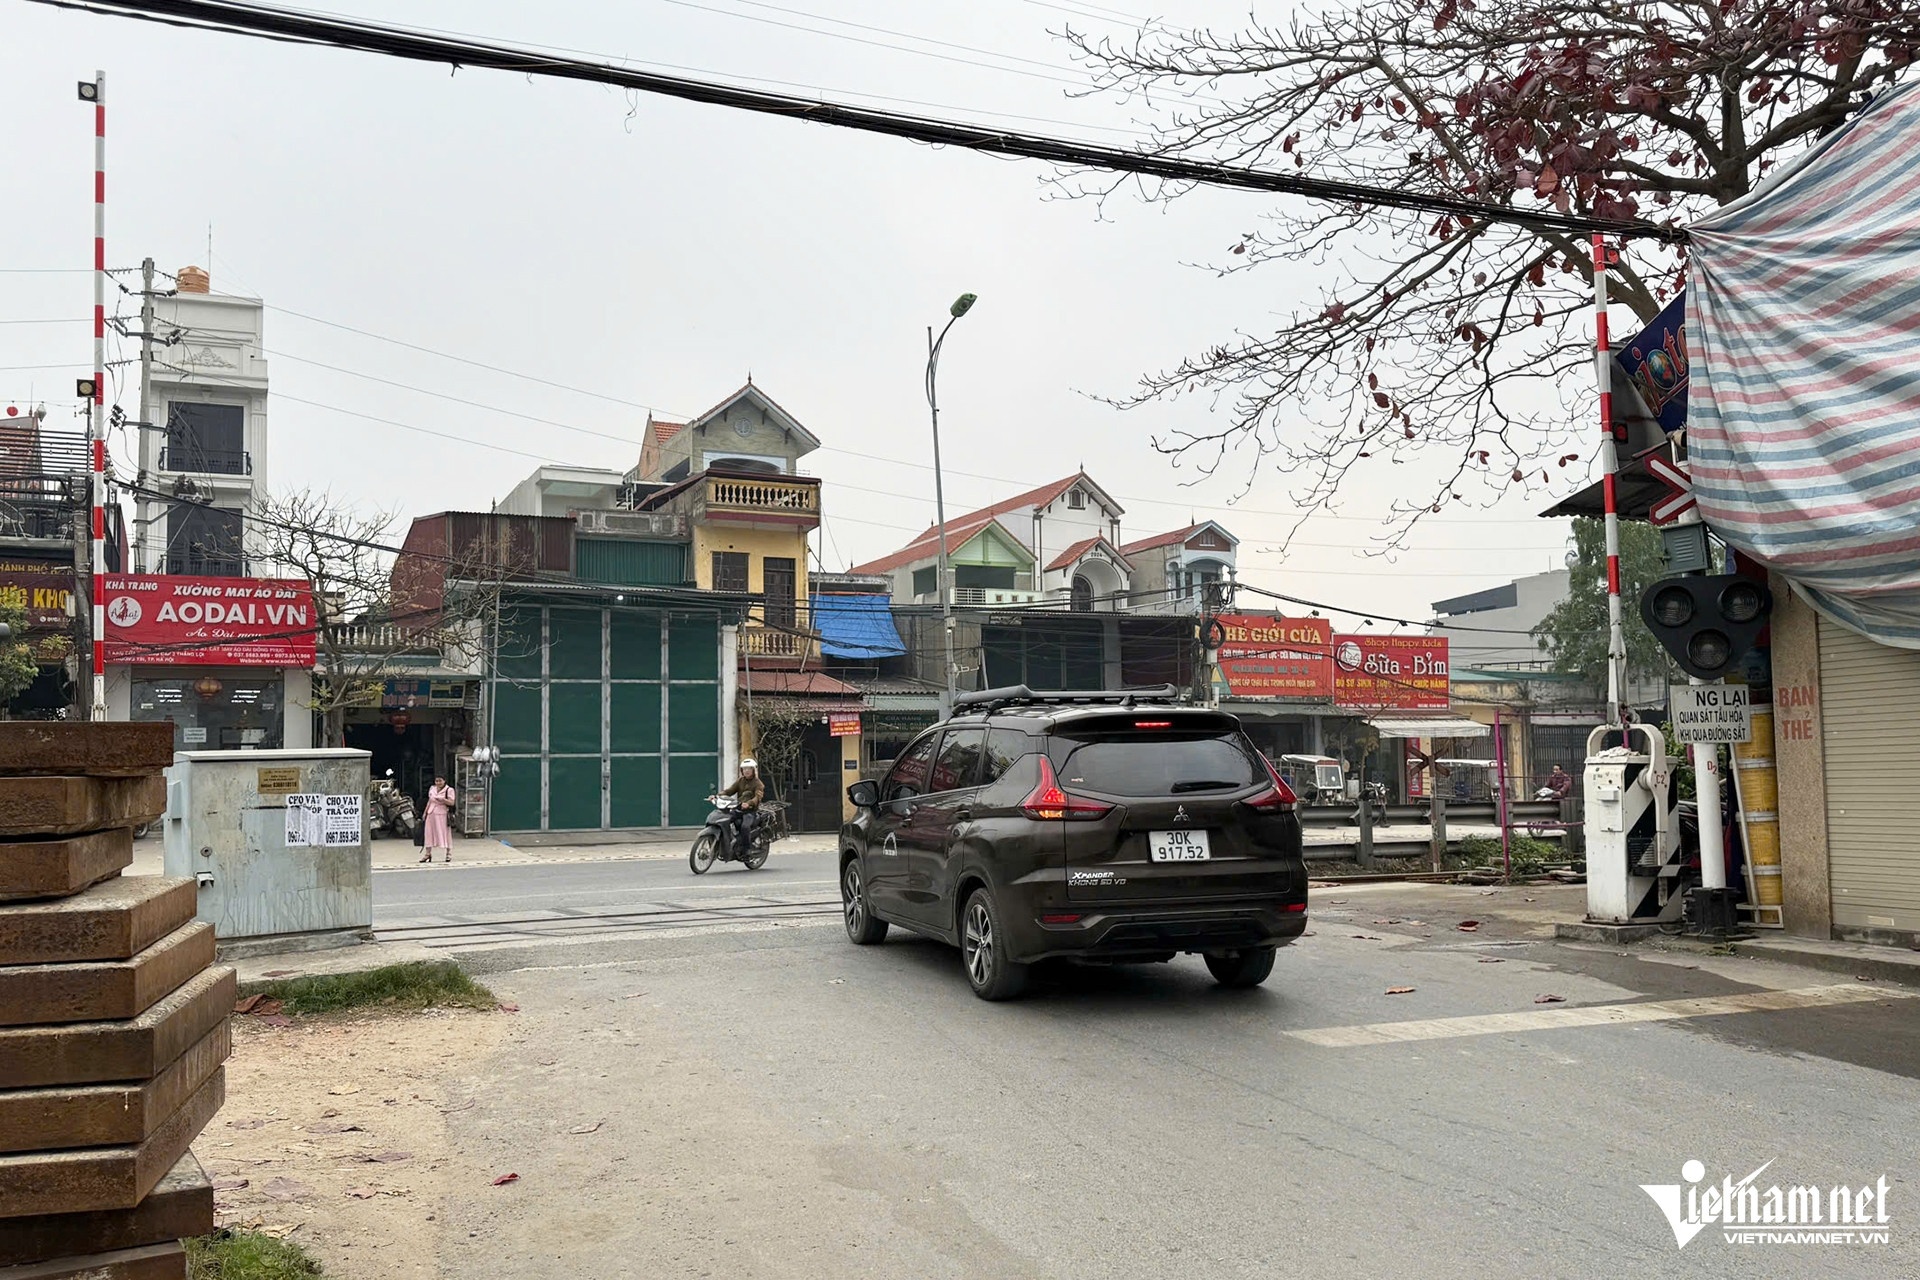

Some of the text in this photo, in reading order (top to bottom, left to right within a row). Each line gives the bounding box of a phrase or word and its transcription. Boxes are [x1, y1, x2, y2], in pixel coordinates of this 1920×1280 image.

[127, 581, 158, 591] TRANG
[173, 582, 222, 597] XƯỞNG
[225, 587, 253, 598] MAY
[253, 585, 272, 599] ÁO
[156, 601, 307, 626] AODAI.VN
[1224, 619, 1322, 645] HẾ GIỚI CỬA
[1365, 638, 1442, 649] Shop Happy Kids
[1364, 653, 1400, 675] Sữa
[1413, 651, 1448, 675] Bỉm
[1723, 690, 1747, 708] LẠI
[1679, 711, 1699, 724] QUAN
[1700, 707, 1713, 723] SÁT
[1680, 723, 1746, 741] KHI QUA ĐƯỜNG SẮT
[1782, 711, 1814, 740] THẺ
[1655, 775, 1665, 784] C2
[326, 796, 358, 806] CHO VAY
[326, 806, 359, 815] TRẢ GÓP
[1167, 832, 1191, 845] 30K
[1159, 846, 1204, 860] 917.52
